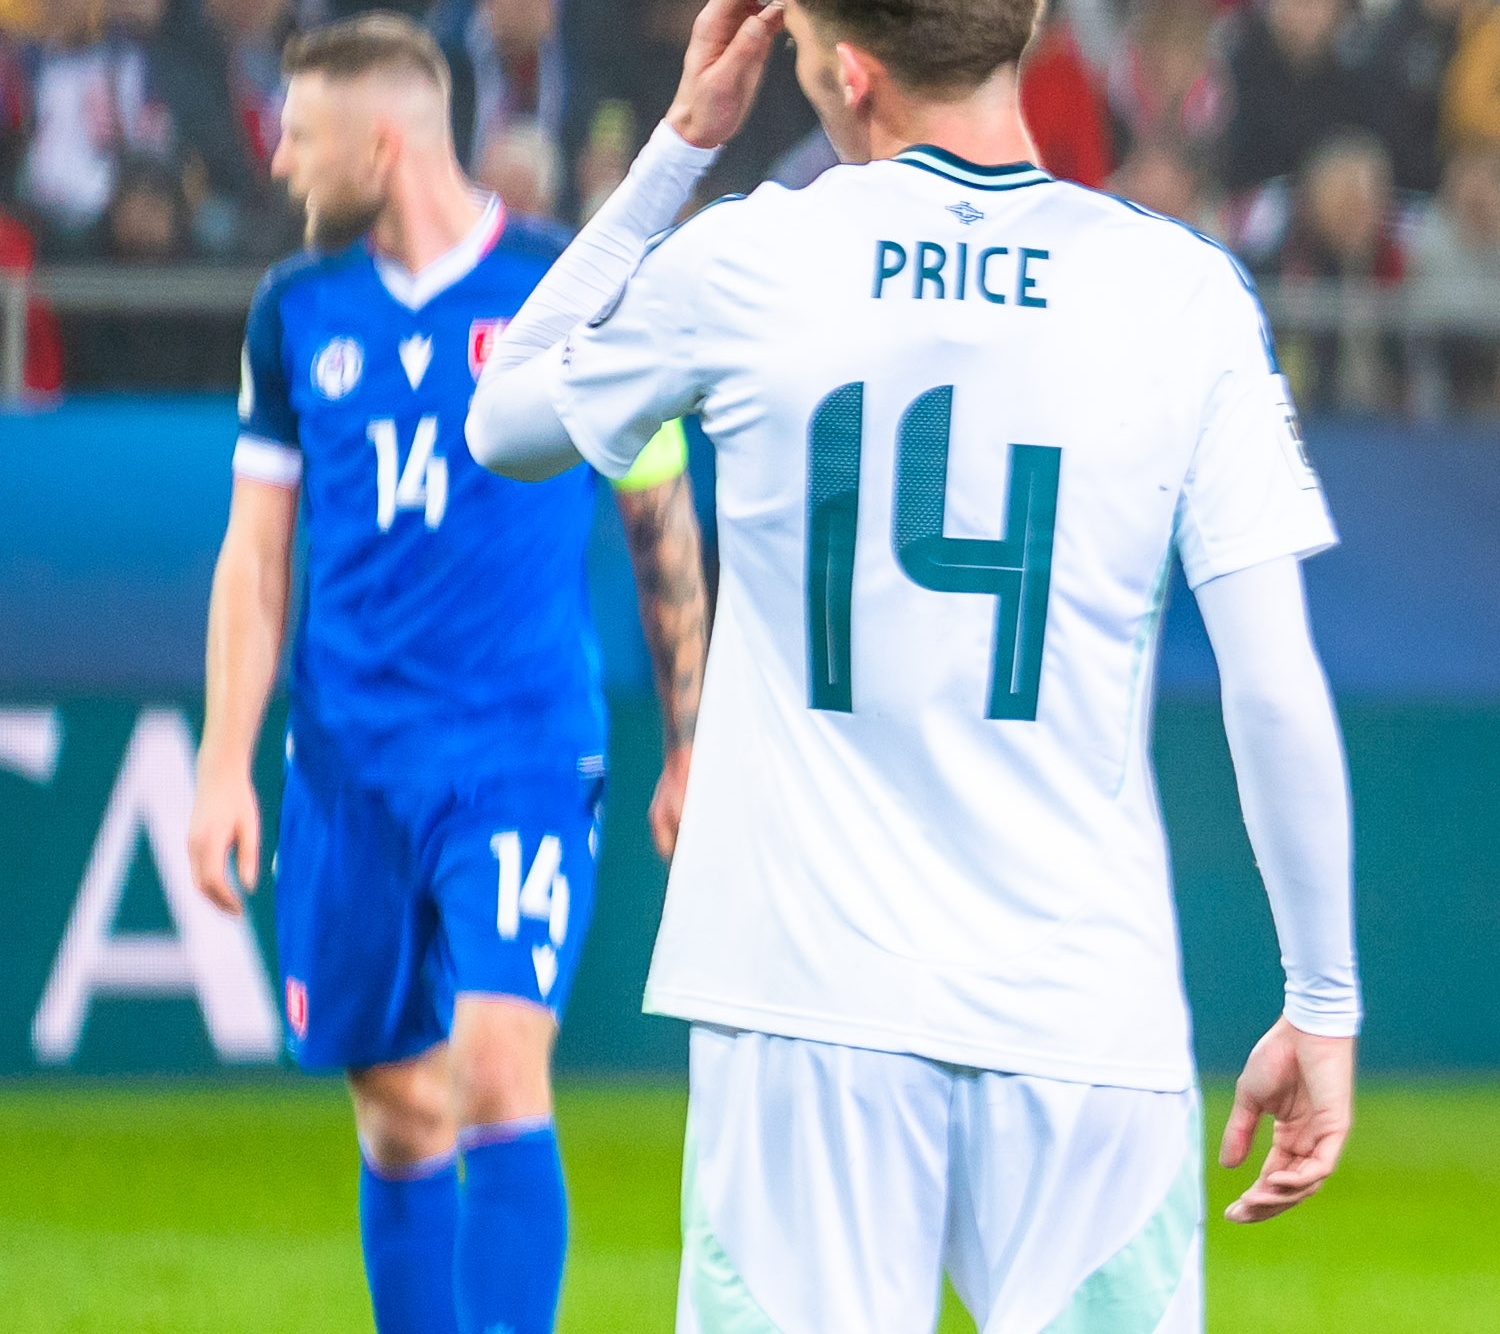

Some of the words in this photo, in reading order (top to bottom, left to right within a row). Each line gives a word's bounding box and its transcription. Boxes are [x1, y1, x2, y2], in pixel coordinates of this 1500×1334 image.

[871, 238, 1050, 309] PRICE
[366, 412, 449, 533] 14
[806, 380, 1062, 722] 14
[490, 829, 571, 949] 14
